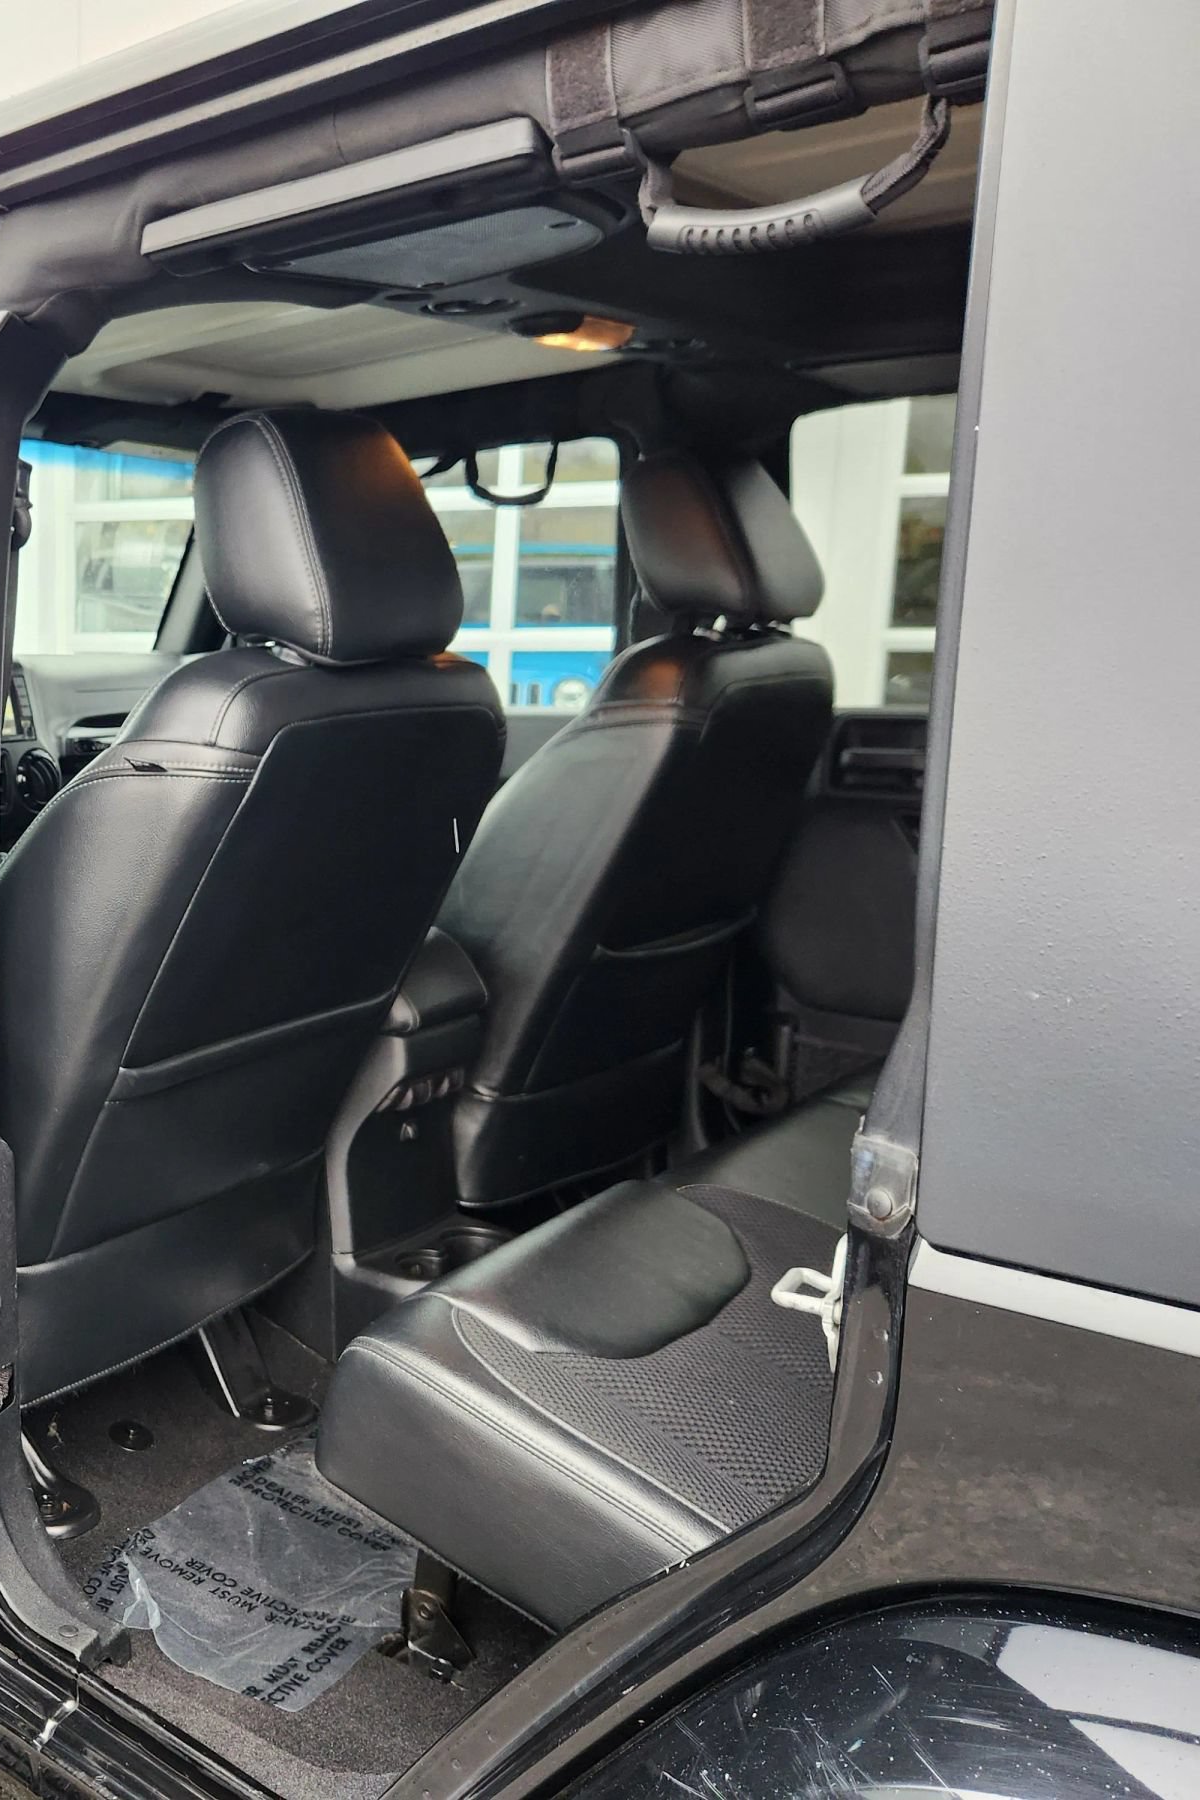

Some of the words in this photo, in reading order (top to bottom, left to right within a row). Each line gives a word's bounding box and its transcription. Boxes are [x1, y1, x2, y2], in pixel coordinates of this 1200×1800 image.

[242, 1484, 333, 1528] PROTECTIVE
[337, 1527, 391, 1551] COVER
[316, 1506, 363, 1530] MUST
[139, 1547, 205, 1586] REMOVE
[185, 1557, 238, 1588] COVER
[209, 1586, 259, 1613] MUST
[263, 1657, 300, 1684] MUST
[306, 1637, 352, 1673] COVER
